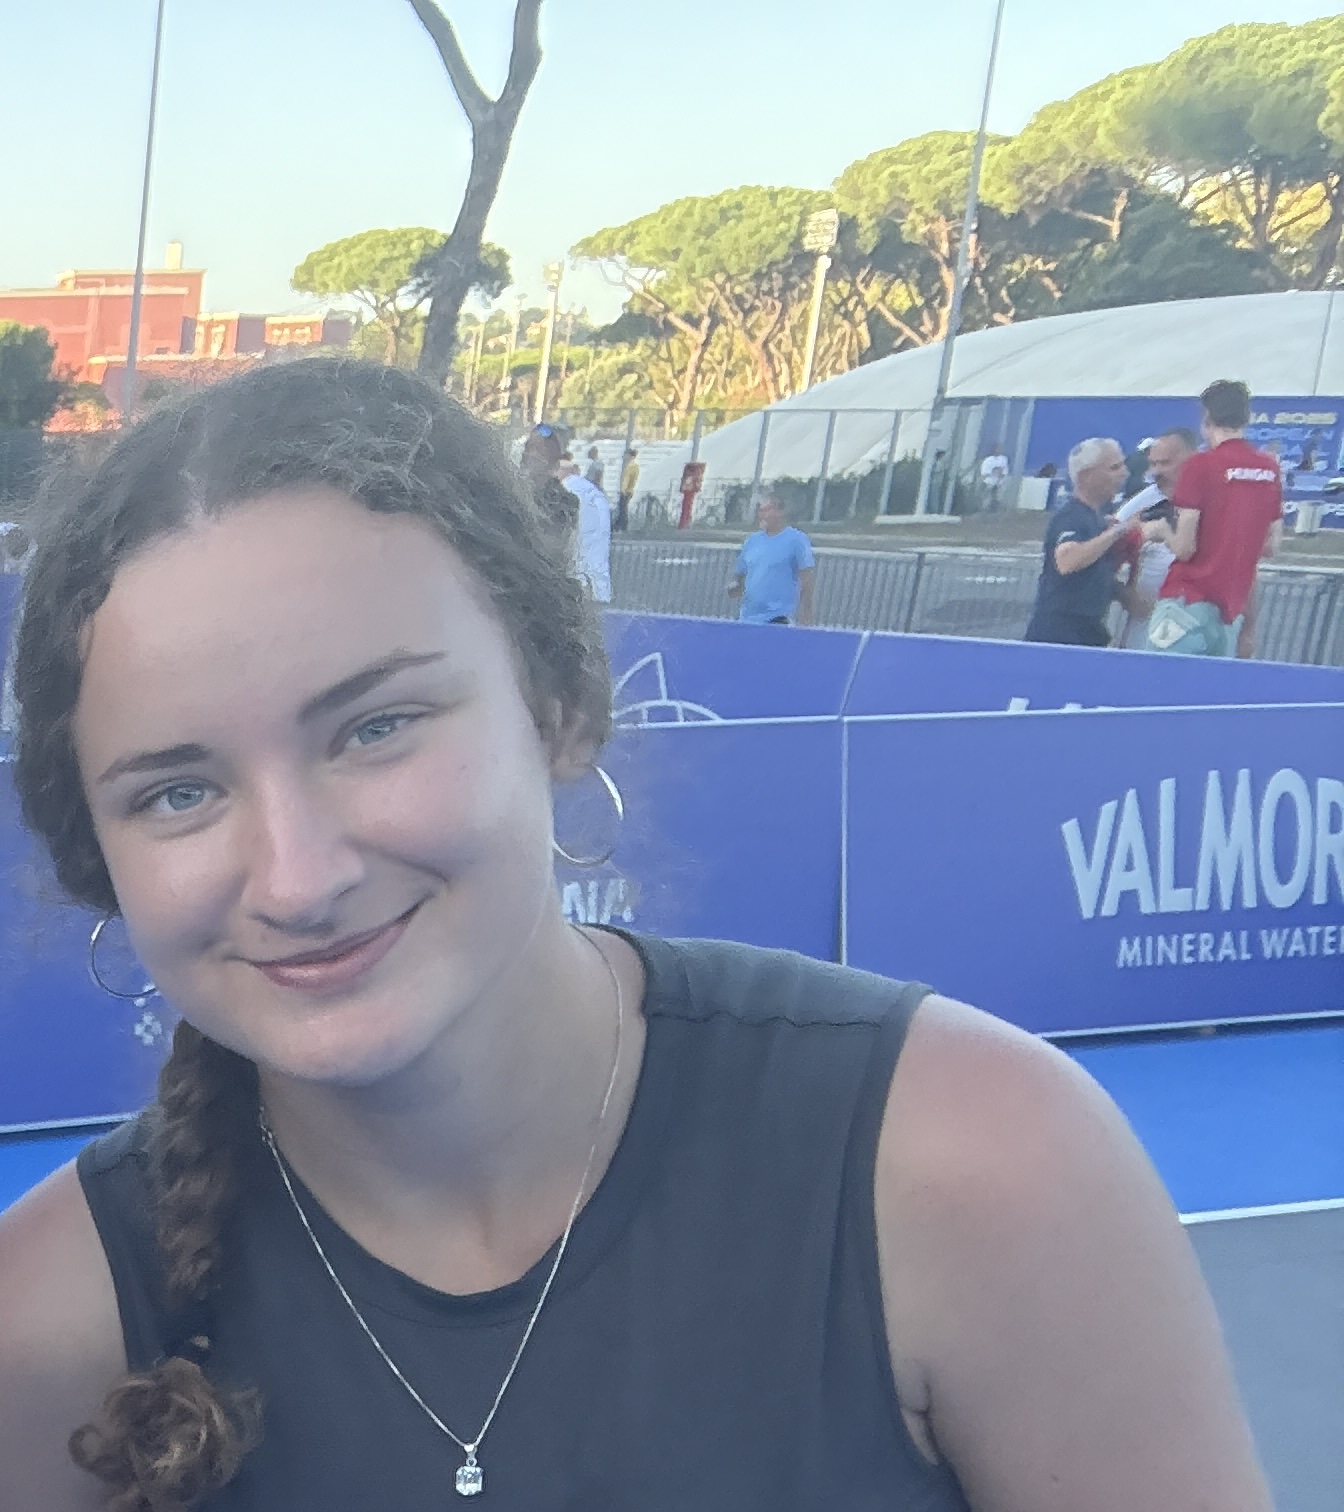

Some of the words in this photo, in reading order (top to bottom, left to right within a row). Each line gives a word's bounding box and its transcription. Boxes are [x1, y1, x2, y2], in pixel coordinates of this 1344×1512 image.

[1061, 767, 1344, 919] VALMOR
[1116, 930, 1252, 968] MINERAL
[1261, 925, 1344, 959] WATE
